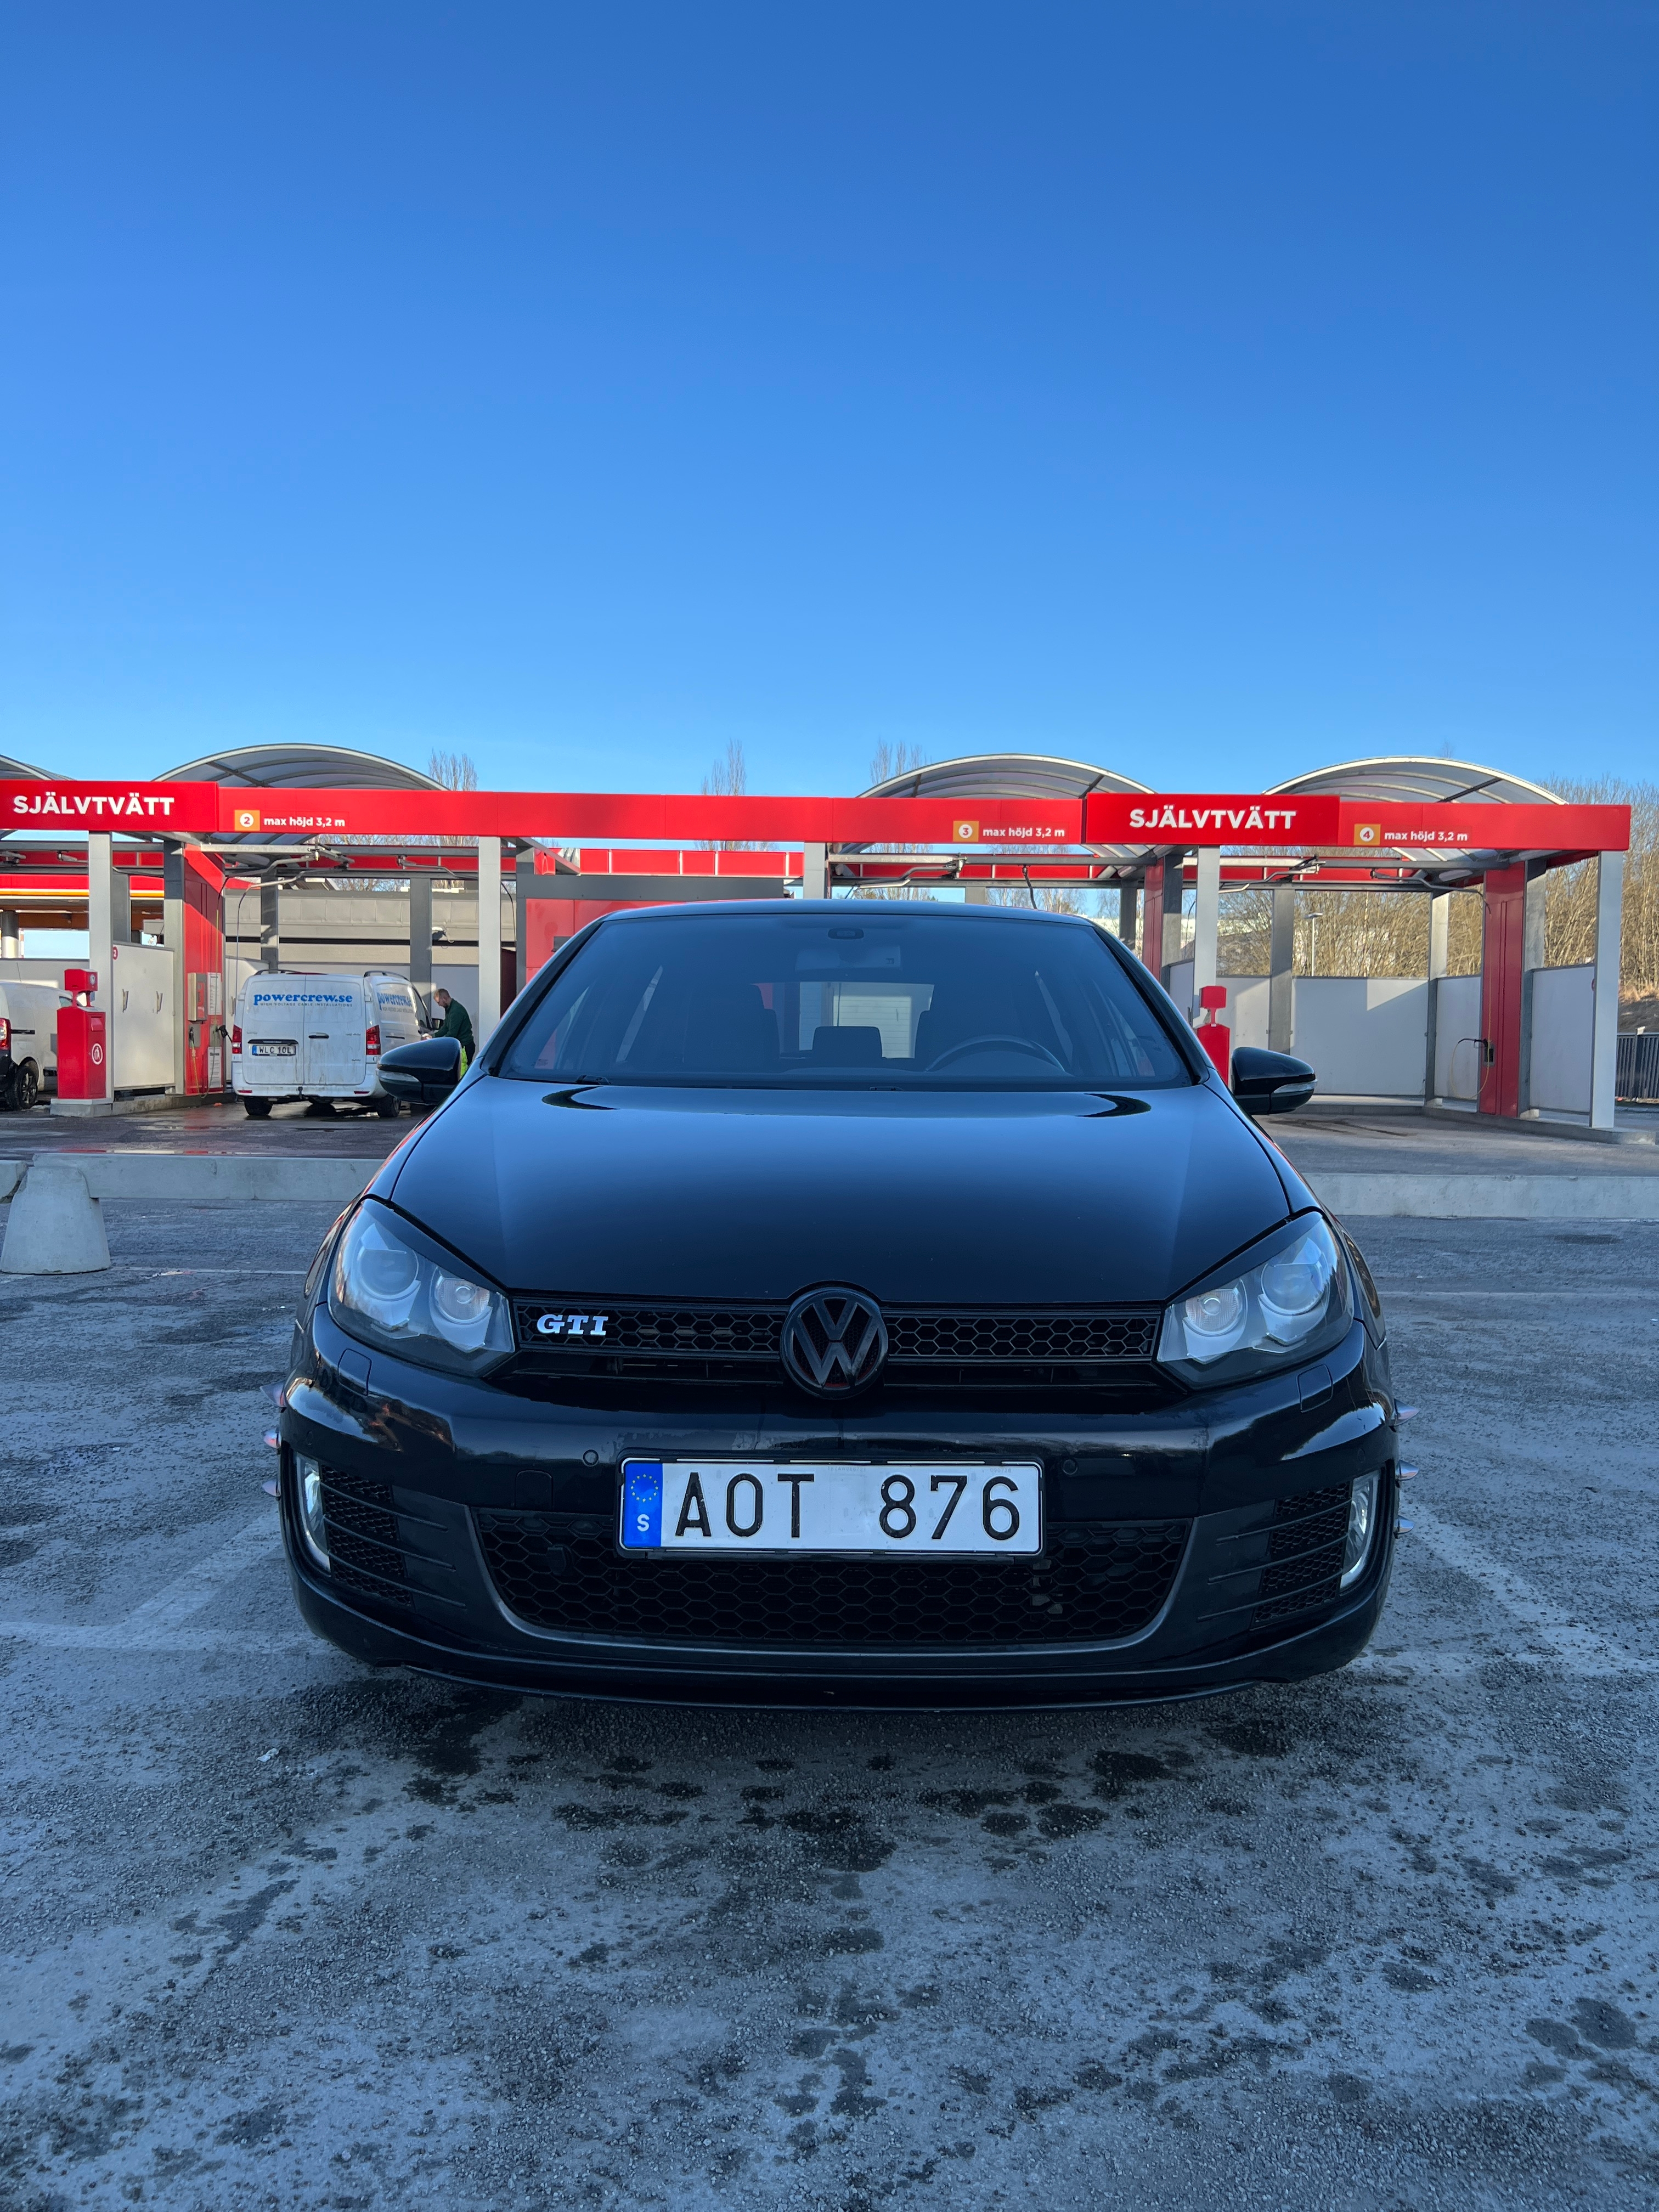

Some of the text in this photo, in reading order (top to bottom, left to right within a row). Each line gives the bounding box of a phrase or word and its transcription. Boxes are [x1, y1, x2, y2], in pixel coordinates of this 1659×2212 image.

[13, 792, 175, 815] SJÄLVTVÄTT
[244, 816, 251, 825] 2
[264, 816, 345, 828] max höjd 3,2 m
[1129, 804, 1296, 829] SJÄLVTVÄTT
[962, 827, 969, 836] 3
[983, 827, 1065, 838] max höjd 3,2 m
[1363, 831, 1370, 839] 4
[1384, 831, 1468, 842] max höjd 3,2 m
[253, 994, 353, 1006] powercrew.se
[537, 1313, 609, 1336] GTI
[675, 1471, 1020, 1541] AOT 876
[636, 1513, 650, 1532] S
